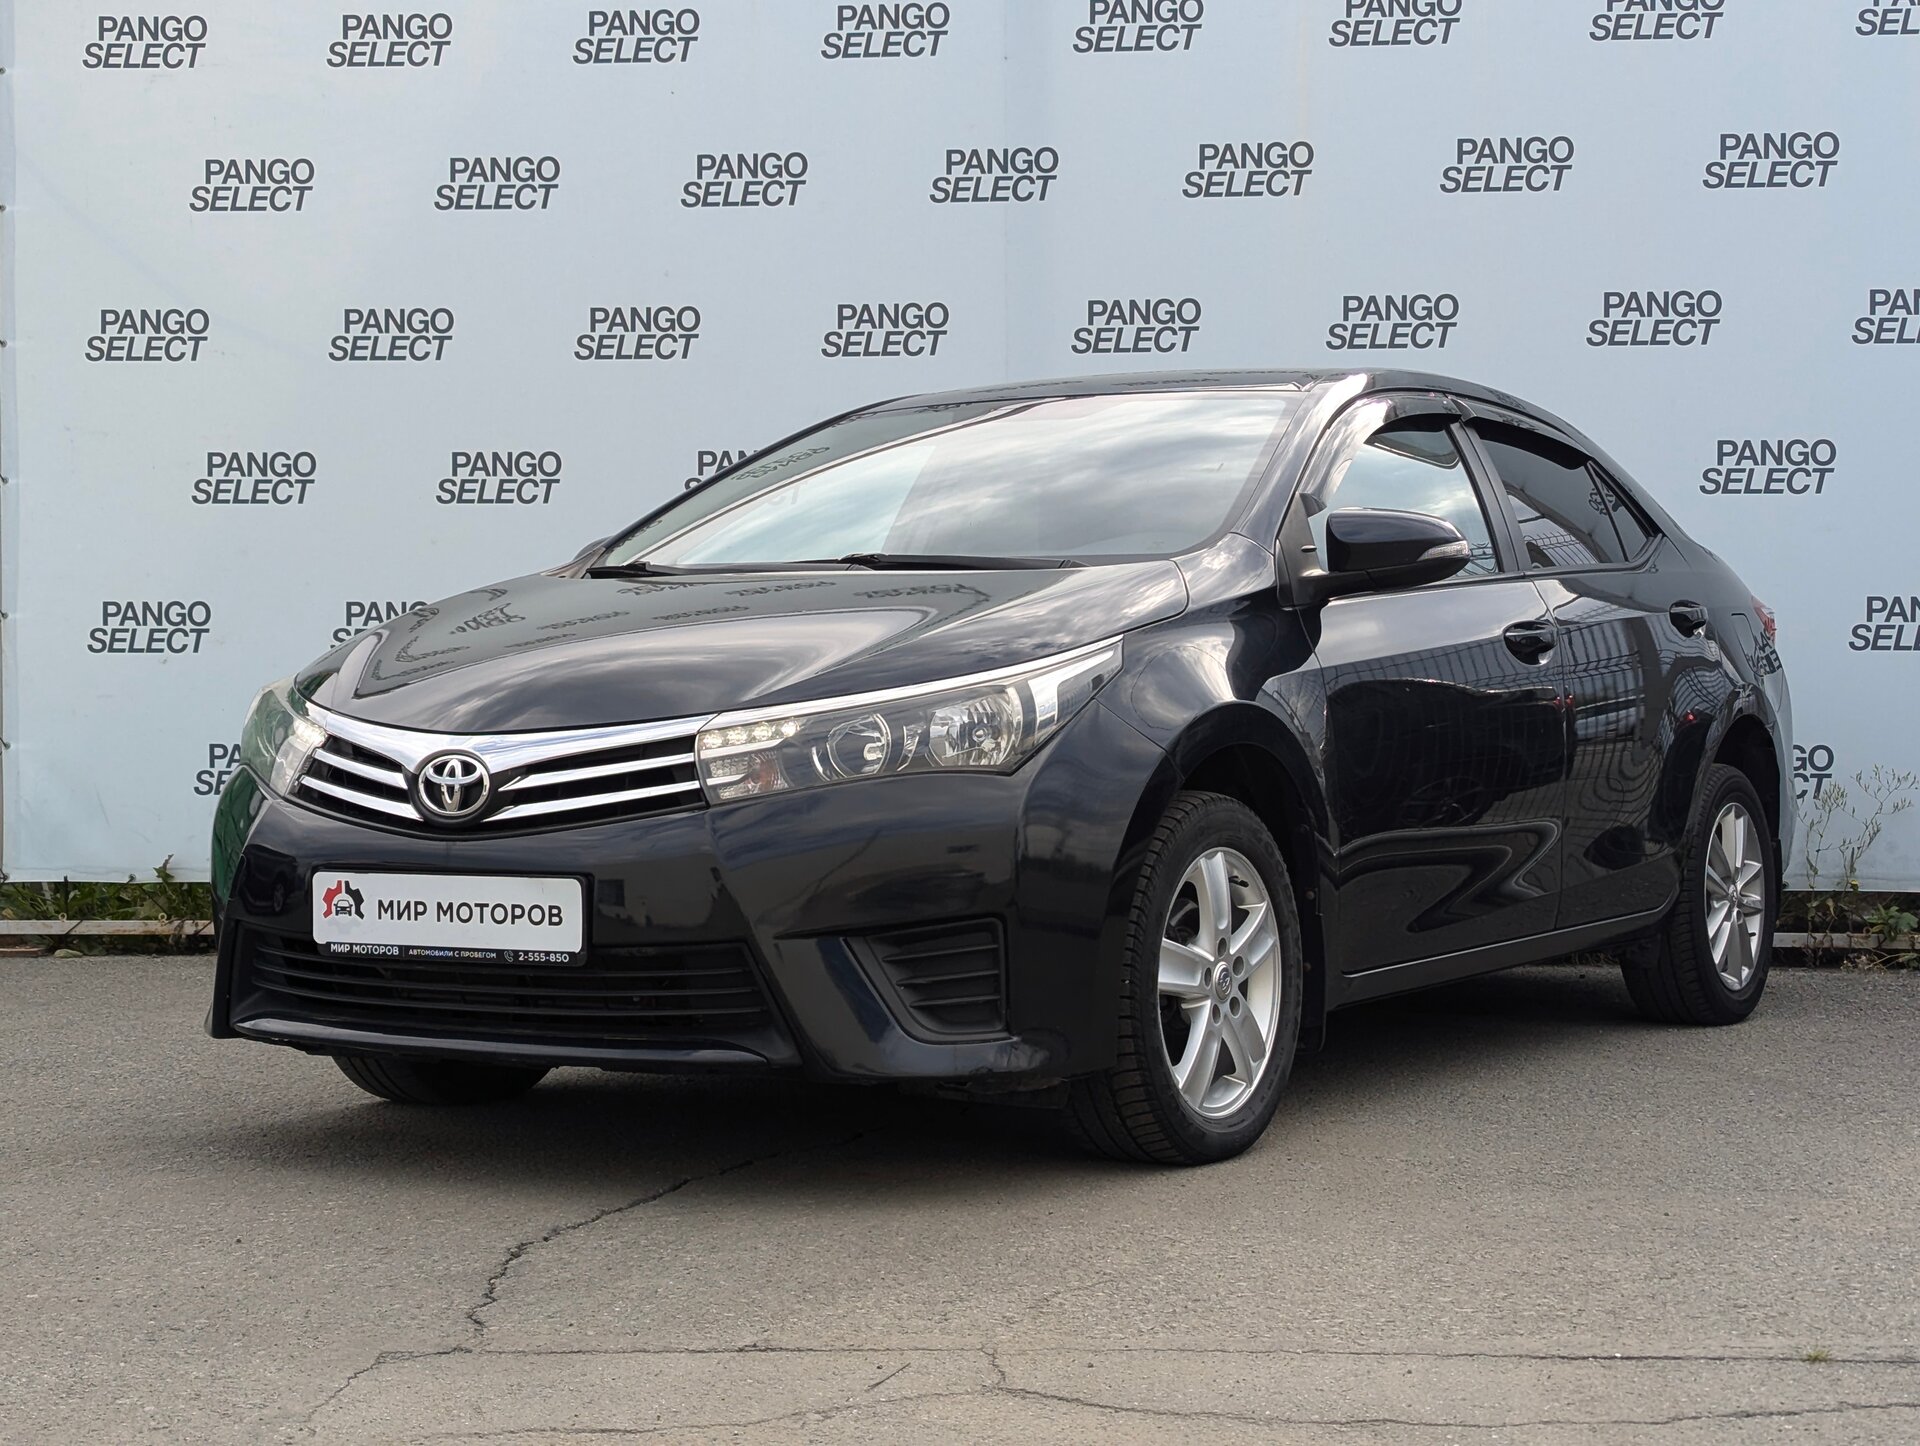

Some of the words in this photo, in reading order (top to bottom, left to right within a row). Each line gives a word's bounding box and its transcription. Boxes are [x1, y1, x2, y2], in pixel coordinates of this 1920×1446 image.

[589, 9, 699, 36] PANGO
[838, 2, 950, 31] PANGO
[1090, 0, 1203, 24] PANGO
[99, 16, 207, 41] PANGO
[343, 13, 452, 40] PANGO
[1073, 24, 1202, 53] SELECT
[1329, 18, 1460, 47] SELECT
[1589, 12, 1723, 41] SELECT
[83, 43, 206, 69] SELECT
[327, 41, 451, 67] SELECT
[573, 36, 698, 64] SELECT
[821, 30, 948, 59] SELECT
[1199, 141, 1314, 170] PANGO
[1457, 136, 1574, 164] PANGO
[1720, 132, 1839, 160] PANGO
[206, 159, 314, 184] PANGO
[450, 156, 560, 182] PANGO
[697, 152, 808, 180] PANGO
[946, 147, 1058, 175] PANGO
[1703, 160, 1838, 188] SELECT
[930, 175, 1057, 203] SELECT
[1182, 170, 1312, 198] SELECT
[1440, 165, 1572, 193] SELECT
[190, 186, 313, 212] SELECT
[434, 184, 558, 210] SELECT
[681, 180, 806, 207] SELECT
[838, 302, 949, 329] PANGO
[1088, 298, 1201, 325] PANGO
[1343, 294, 1459, 321] PANGO
[1604, 290, 1722, 318] PANGO
[101, 309, 209, 334] PANGO
[345, 308, 454, 334] PANGO
[590, 306, 700, 332] PANGO
[1586, 319, 1720, 346] SELECT
[1852, 317, 1920, 344] SEL
[85, 336, 208, 361] SELECT
[329, 335, 452, 361] SELECT
[574, 334, 699, 360] SELECT
[821, 330, 947, 357] SELECT
[1071, 326, 1199, 354] SELECT
[1326, 322, 1457, 350] SELECT
[208, 452, 316, 477] PANGO
[452, 451, 561, 477] PANGO
[1717, 439, 1836, 466] PANGO
[192, 479, 315, 504] SELECT
[436, 478, 560, 504] SELECT
[1700, 468, 1835, 494] SELECT
[103, 601, 211, 627] PANGO
[87, 628, 210, 653] SELECT
[1849, 624, 1920, 651] SEL
[377, 899, 428, 921] МИР
[436, 901, 563, 926] МОТОРОВ
[330, 943, 351, 954] МИР
[352, 945, 400, 956] МОТОРОВ
[408, 949, 453, 957] АВТОМОБИЛИ
[460, 951, 497, 959] ПРОБЕГОМ
[518, 952, 570, 963] 2-555-850
